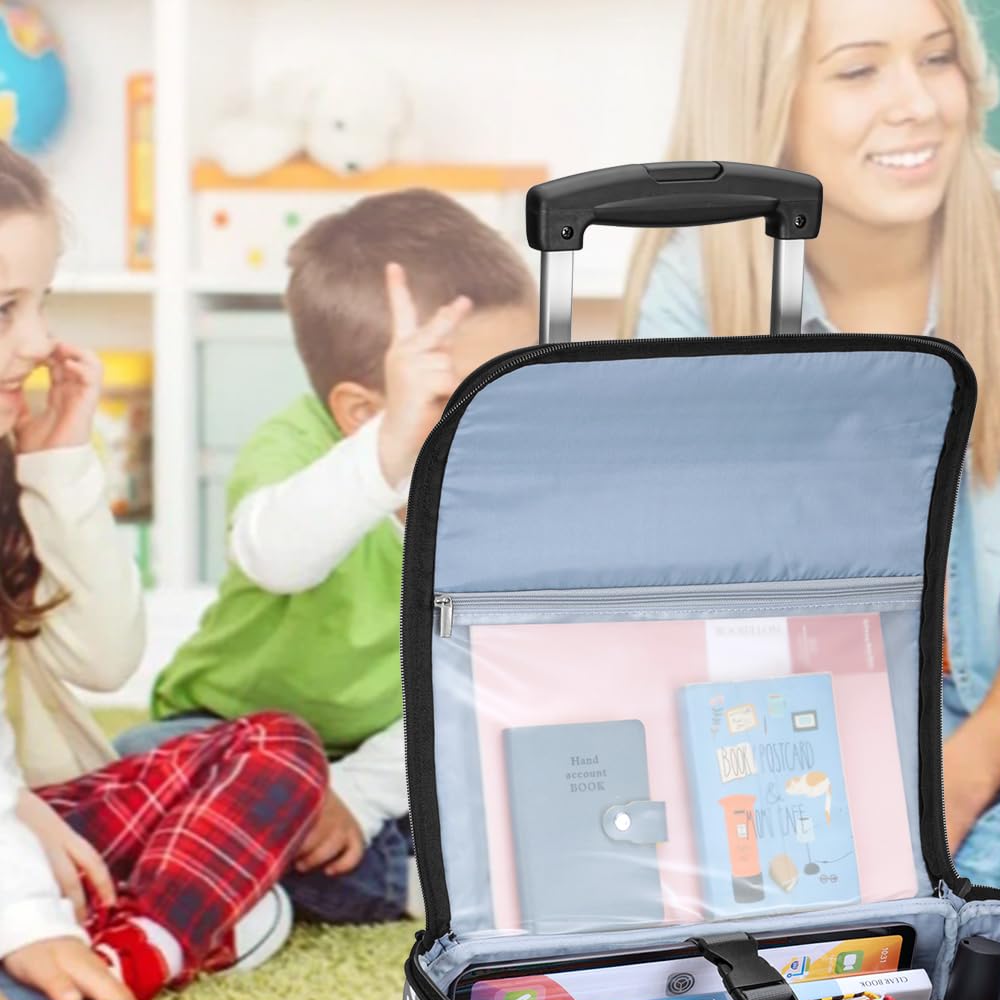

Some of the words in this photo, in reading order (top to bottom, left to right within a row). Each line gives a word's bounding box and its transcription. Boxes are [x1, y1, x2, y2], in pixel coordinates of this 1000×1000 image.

[570, 755, 599, 766] Hand
[721, 746, 752, 777] BOOK
[760, 742, 815, 772] POSTCARD
[566, 770, 607, 780] account
[570, 781, 606, 792] BOOK
[860, 979, 884, 988] BOOK
[885, 976, 909, 986] CLEAR
